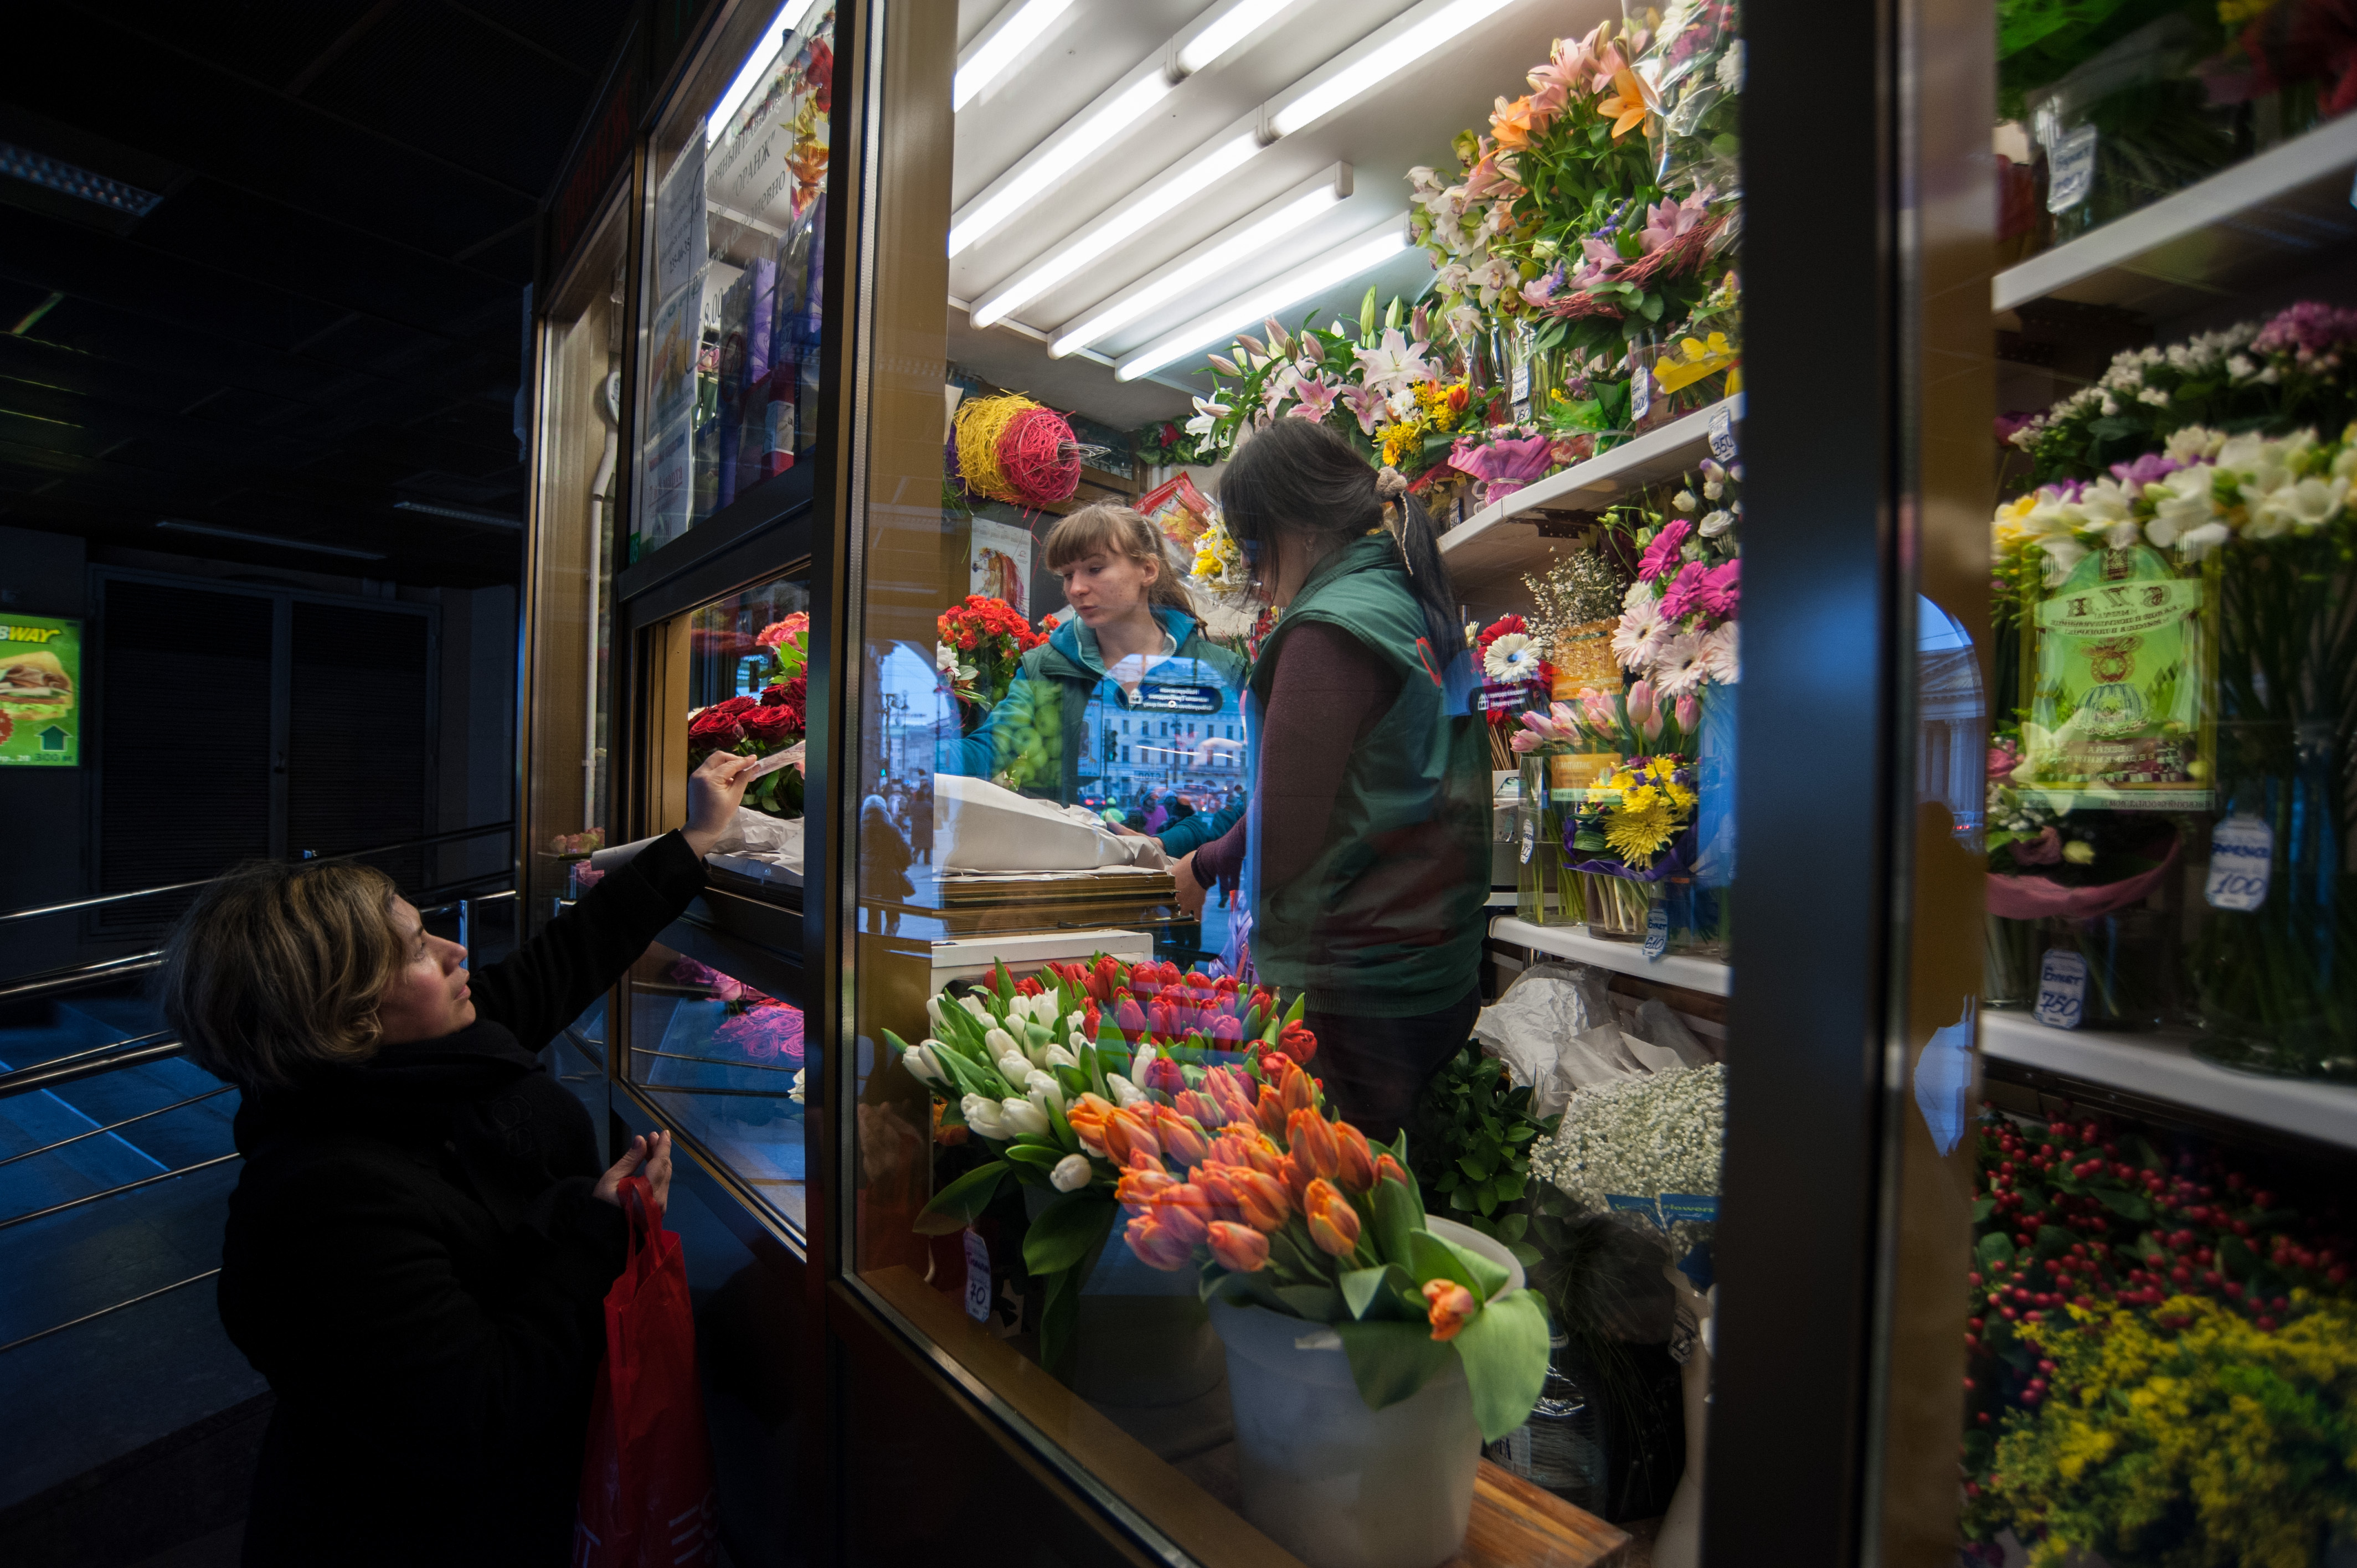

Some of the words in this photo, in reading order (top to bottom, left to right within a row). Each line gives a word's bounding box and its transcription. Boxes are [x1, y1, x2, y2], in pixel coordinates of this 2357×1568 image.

[1713, 434, 1733, 456] 350
[2215, 871, 2265, 895] 100
[2040, 992, 2081, 1015] 750
